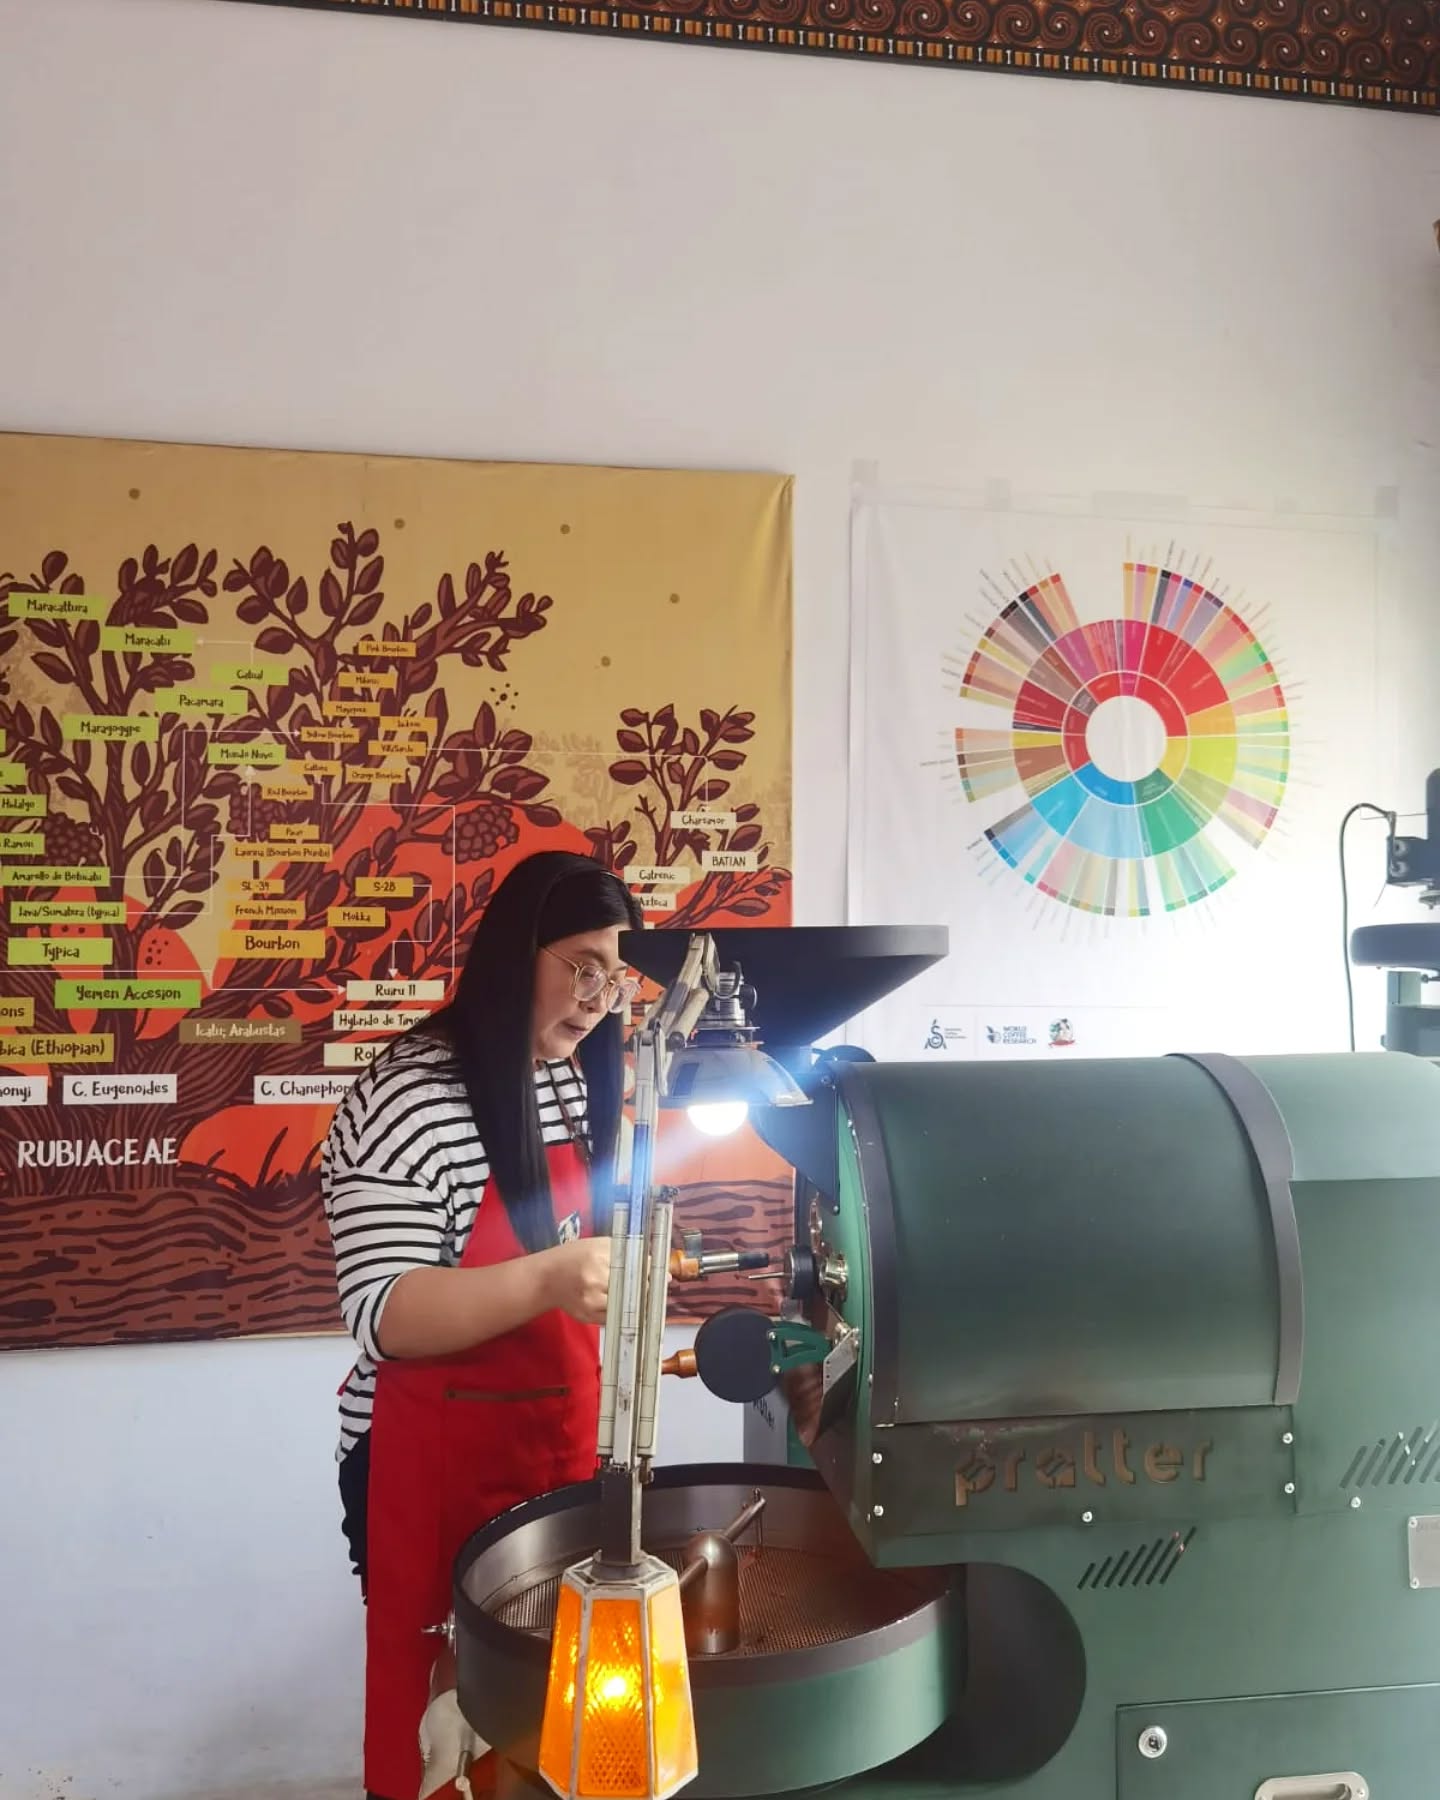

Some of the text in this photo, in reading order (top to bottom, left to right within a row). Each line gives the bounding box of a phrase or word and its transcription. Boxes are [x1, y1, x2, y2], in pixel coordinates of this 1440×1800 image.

[179, 694, 224, 707] Pacamara
[712, 856, 746, 867] BATIAN
[245, 935, 301, 951] Bourbon
[42, 943, 80, 961] Typica
[76, 985, 120, 1001] Yemen
[382, 1014, 394, 1026] de
[31, 1039, 105, 1059] (Ethiopian)
[72, 1080, 169, 1100] C. Eugenoides
[260, 1082, 275, 1097] C.
[18, 1138, 179, 1168] RUBIACEAE
